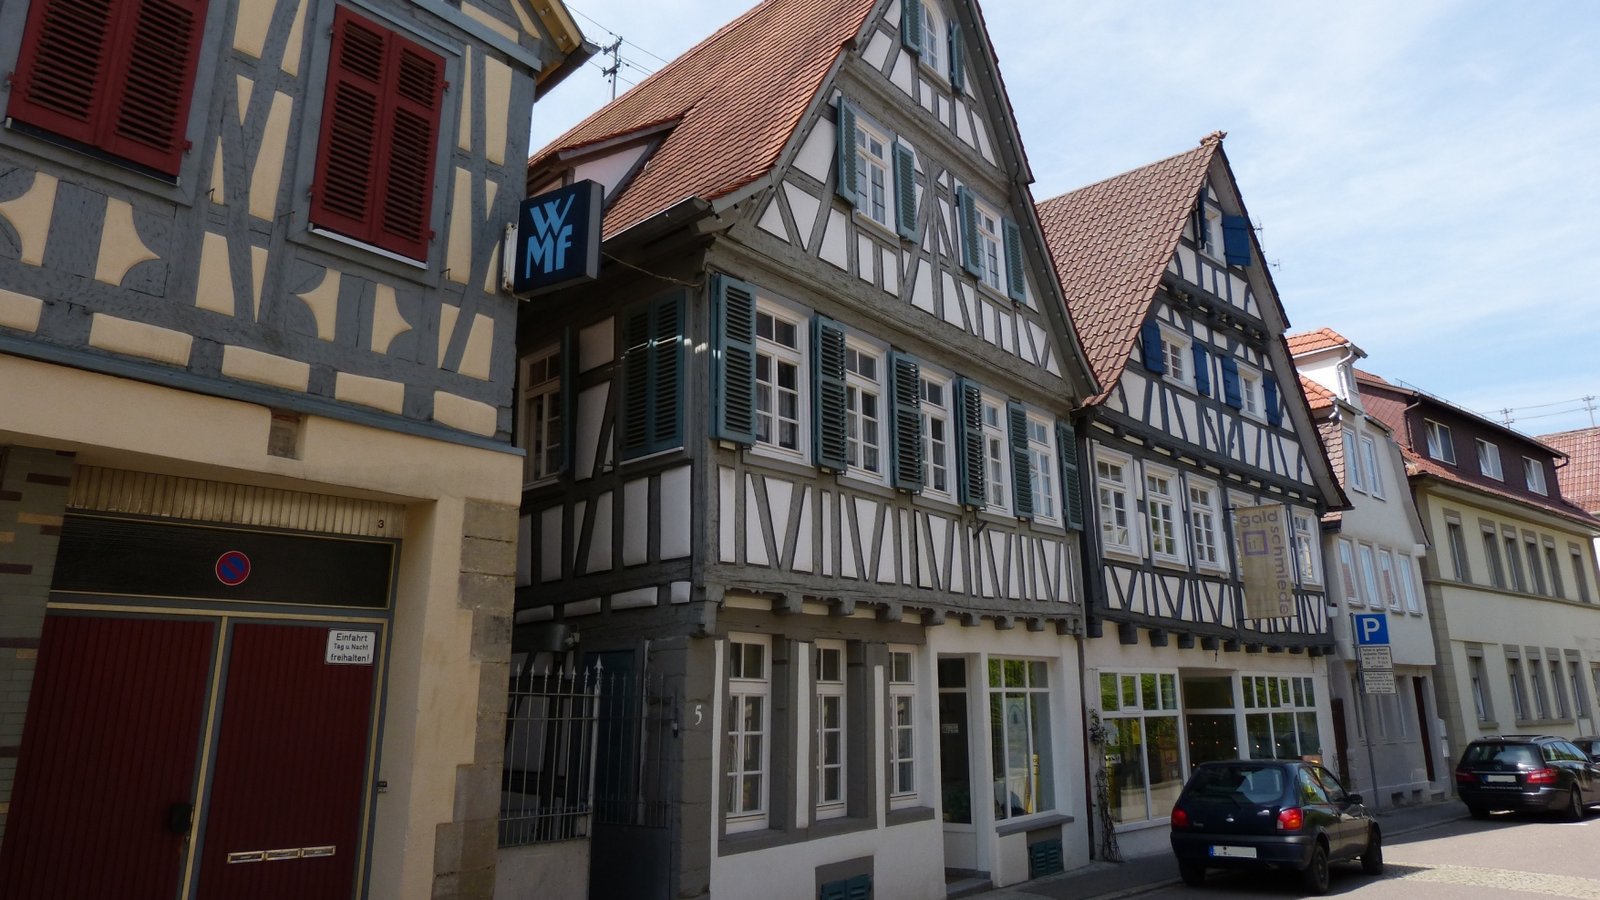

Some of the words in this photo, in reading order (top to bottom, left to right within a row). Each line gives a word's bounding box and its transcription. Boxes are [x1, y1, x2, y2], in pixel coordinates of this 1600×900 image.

[378, 519, 384, 528] 3
[1241, 510, 1278, 528] gold
[1271, 526, 1291, 615] schmiede
[1363, 617, 1380, 641] P
[336, 633, 367, 641] Einfahrt
[334, 643, 344, 651] Tag
[331, 653, 369, 662] freihalten!
[695, 704, 702, 726] 5
